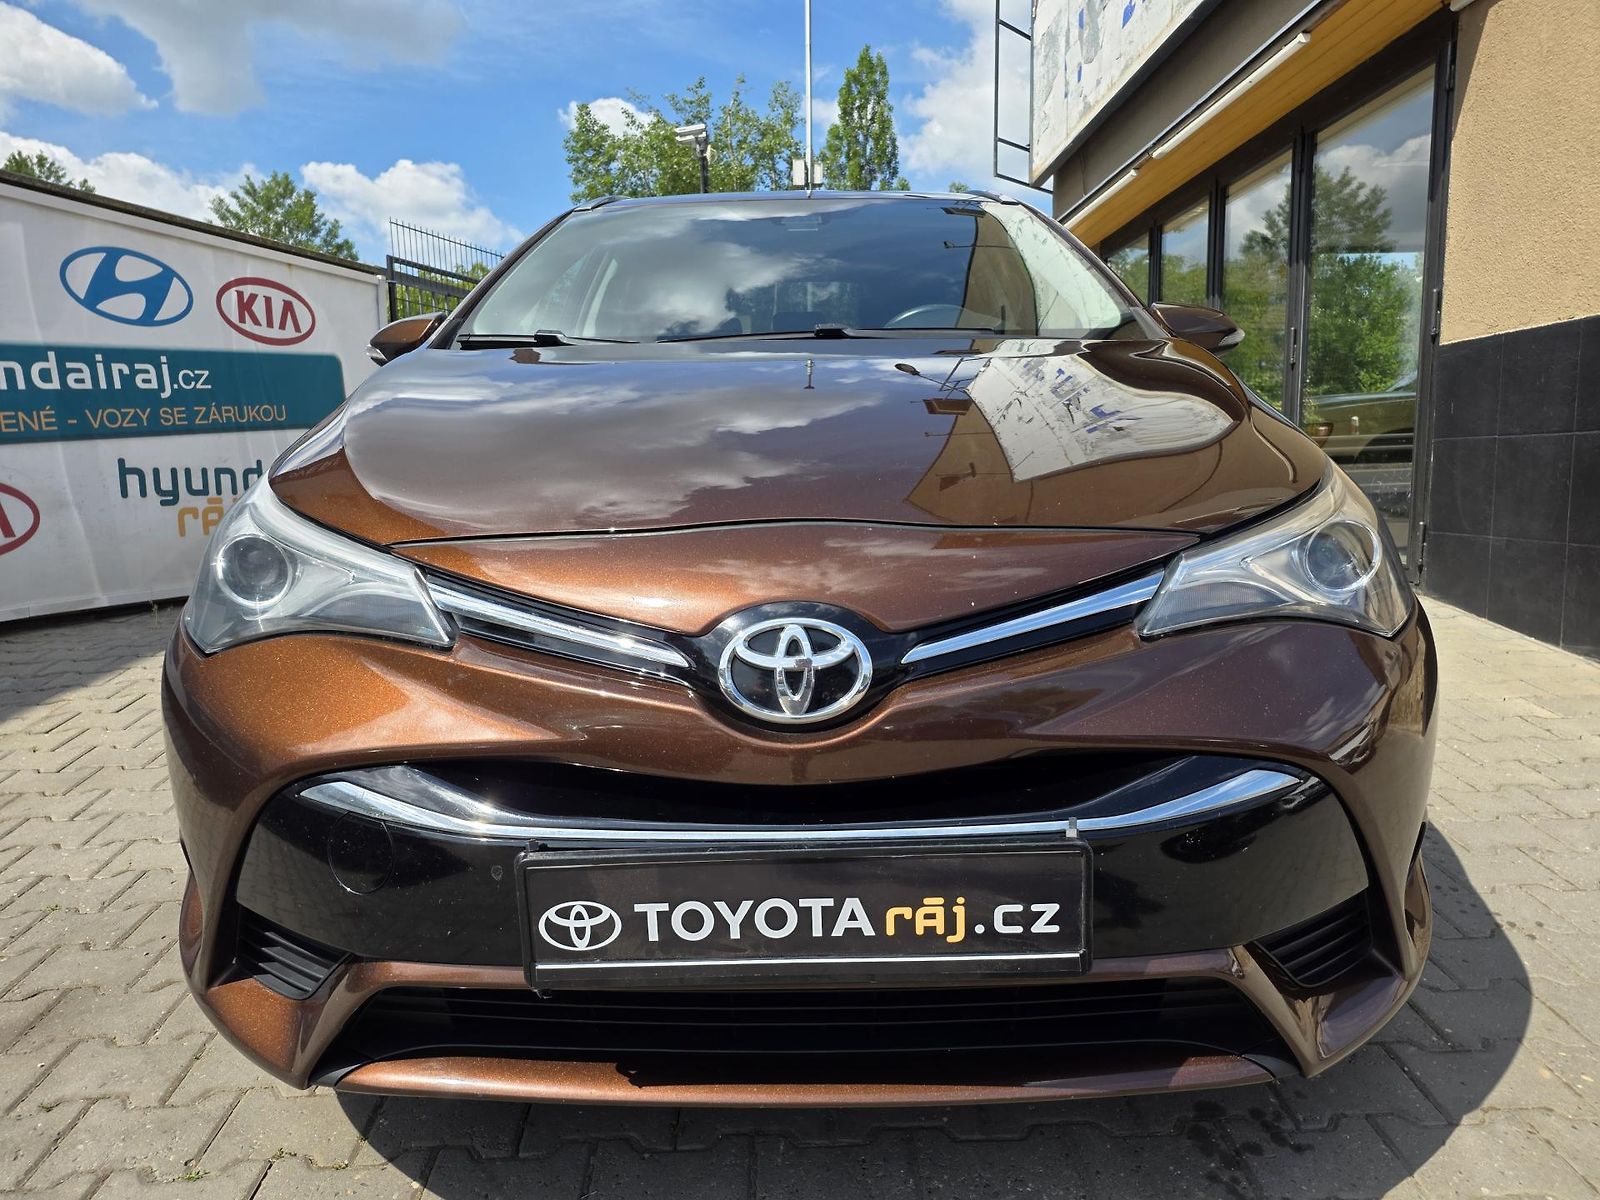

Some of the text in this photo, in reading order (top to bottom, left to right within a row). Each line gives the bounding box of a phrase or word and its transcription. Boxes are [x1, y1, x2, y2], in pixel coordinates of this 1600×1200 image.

[234, 289, 302, 334] KIA
[0, 405, 58, 432] ENÉ
[85, 408, 151, 429] VOZY
[160, 407, 188, 425] SE
[194, 402, 287, 425] ZÁRUKOU
